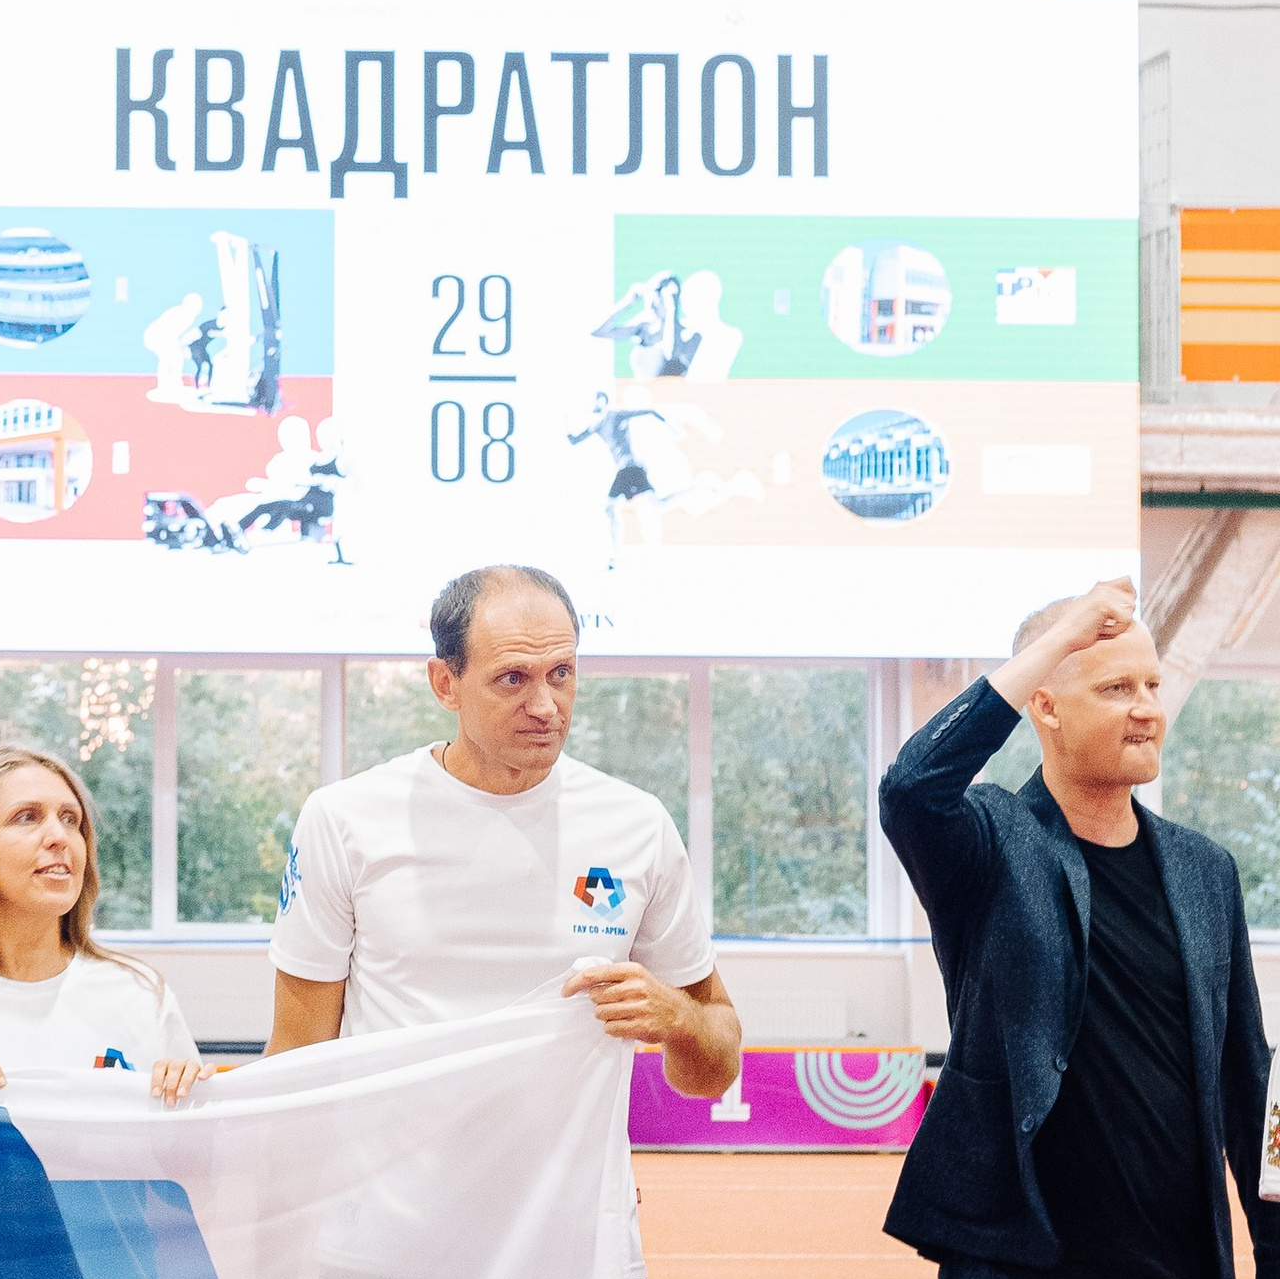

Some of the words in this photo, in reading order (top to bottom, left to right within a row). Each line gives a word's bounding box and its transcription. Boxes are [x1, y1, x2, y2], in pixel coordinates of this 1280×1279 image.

[115, 47, 829, 199] КВАДРАТЛОН
[431, 273, 513, 357] 29
[429, 400, 516, 484] 08
[573, 924, 587, 933] ГАУ
[588, 925, 599, 934] СО
